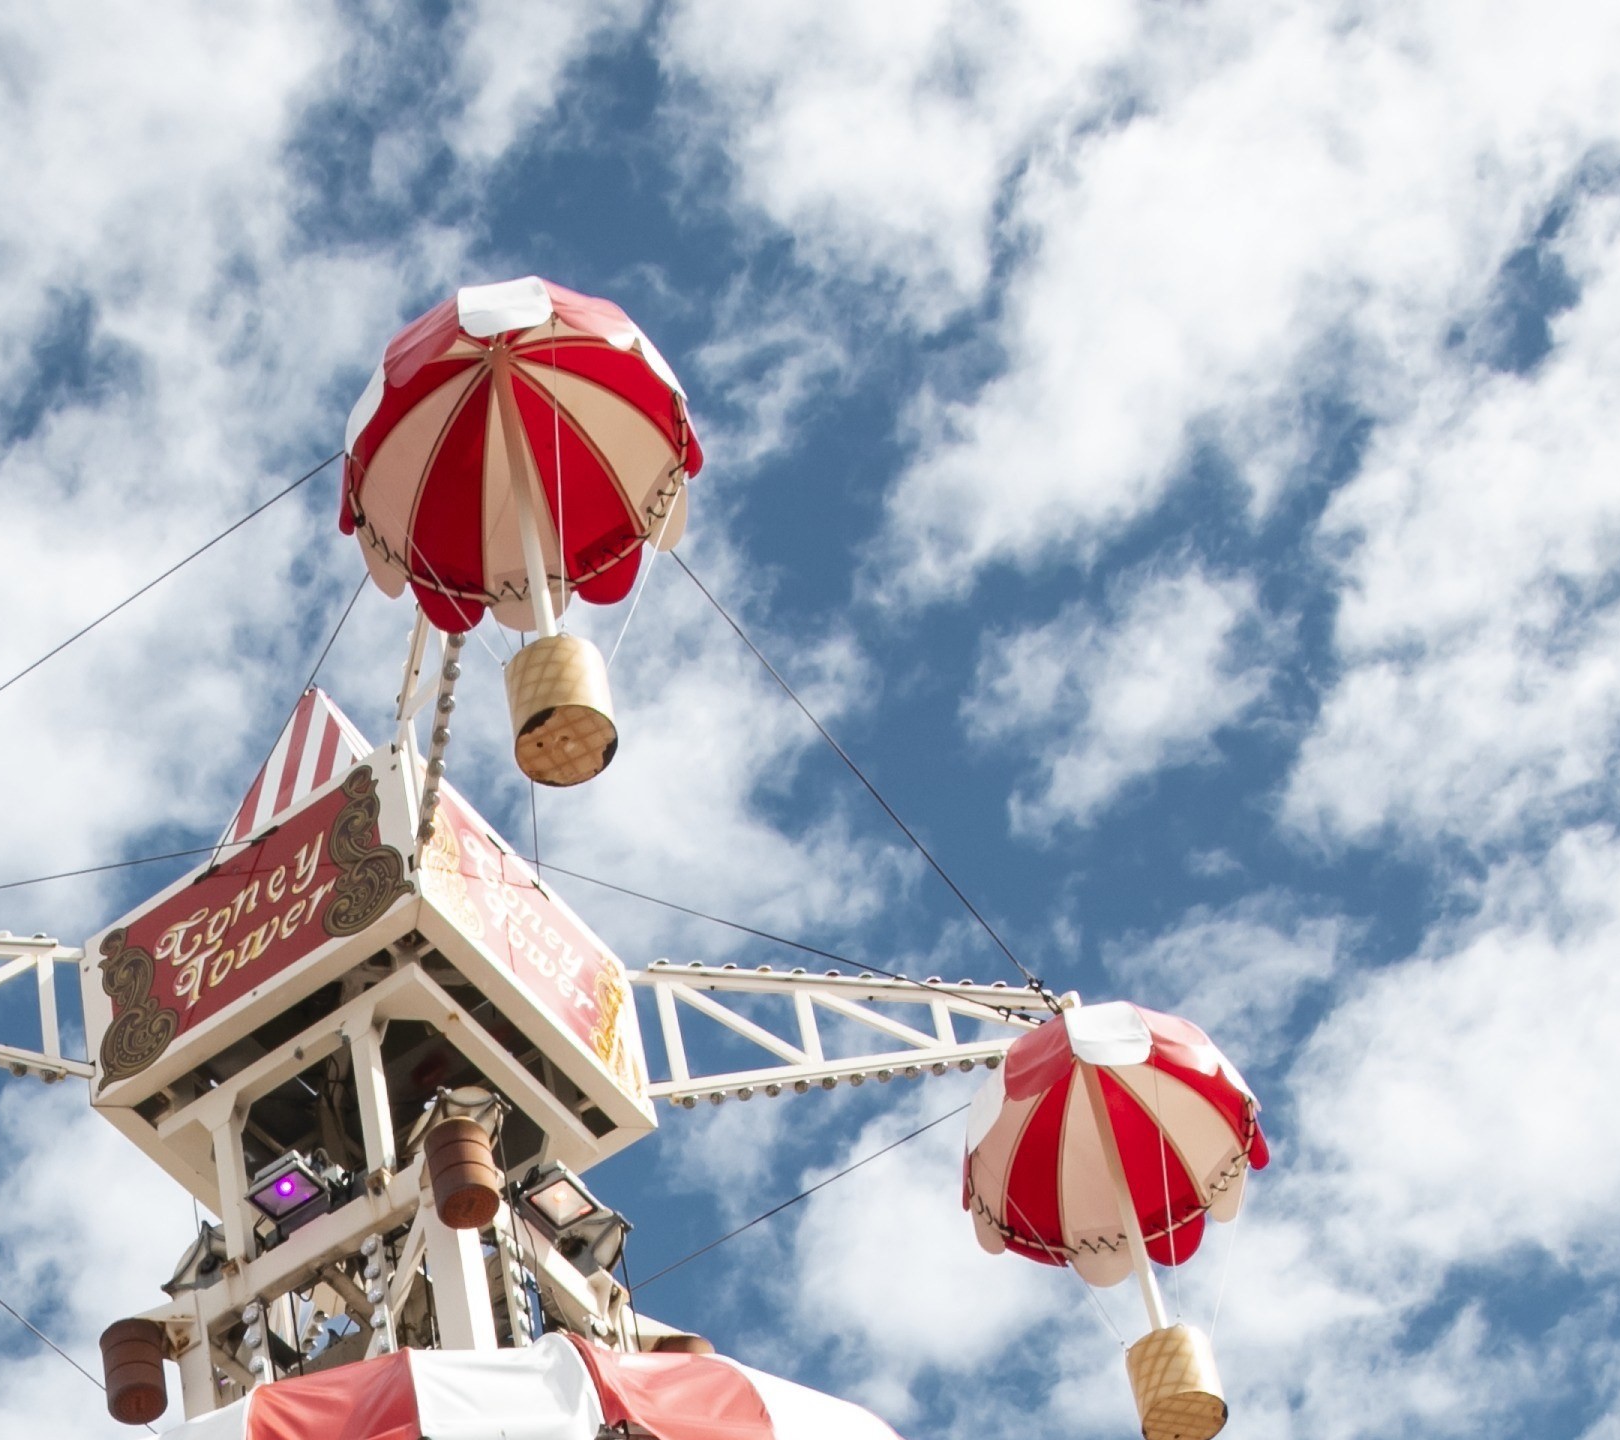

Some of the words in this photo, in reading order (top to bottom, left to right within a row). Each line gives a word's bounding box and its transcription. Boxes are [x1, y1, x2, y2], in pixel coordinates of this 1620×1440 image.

[155, 830, 325, 967] Coney
[172, 876, 337, 1011] Tower
[461, 834, 585, 979] Coney
[484, 891, 595, 1010] Tower
